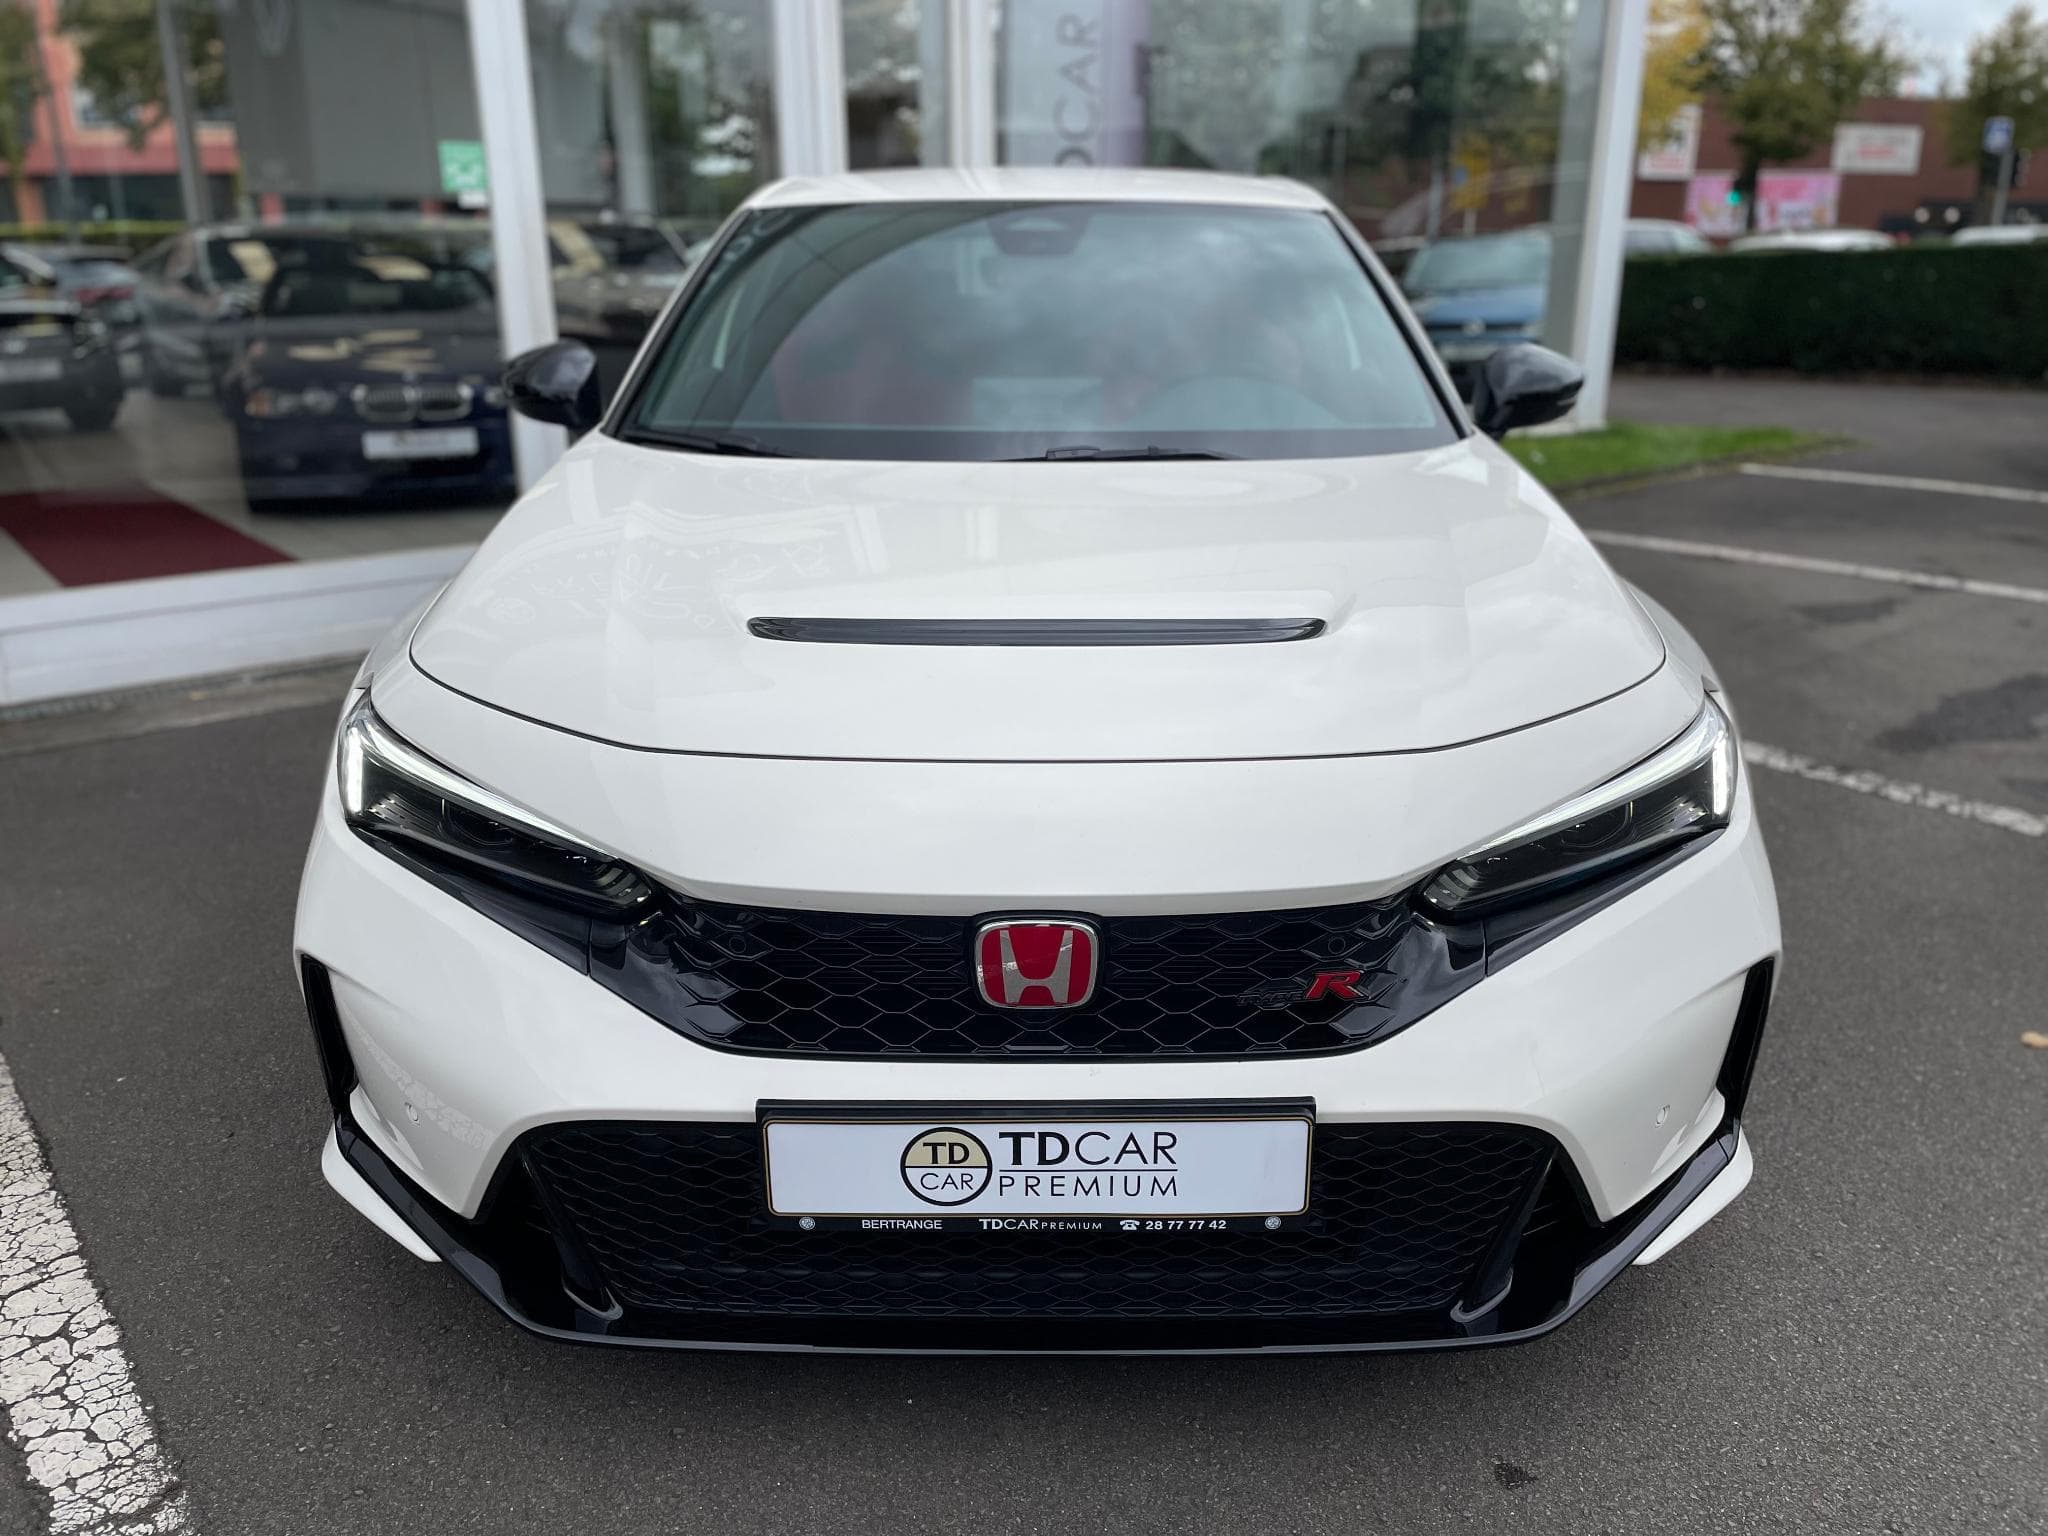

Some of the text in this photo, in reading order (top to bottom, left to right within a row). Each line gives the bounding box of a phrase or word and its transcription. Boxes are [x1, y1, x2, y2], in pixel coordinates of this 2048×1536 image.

[1304, 970, 1368, 1001] R
[922, 1141, 970, 1165] TD
[998, 1131, 1178, 1166] TDCAR
[920, 1172, 974, 1191] CAR
[999, 1175, 1178, 1197] PREMIUM
[861, 1219, 943, 1230] BERTRANGE
[978, 1218, 1102, 1230] TDCAR PREMIUM
[1145, 1219, 1227, 1230] 28 77 77 42
